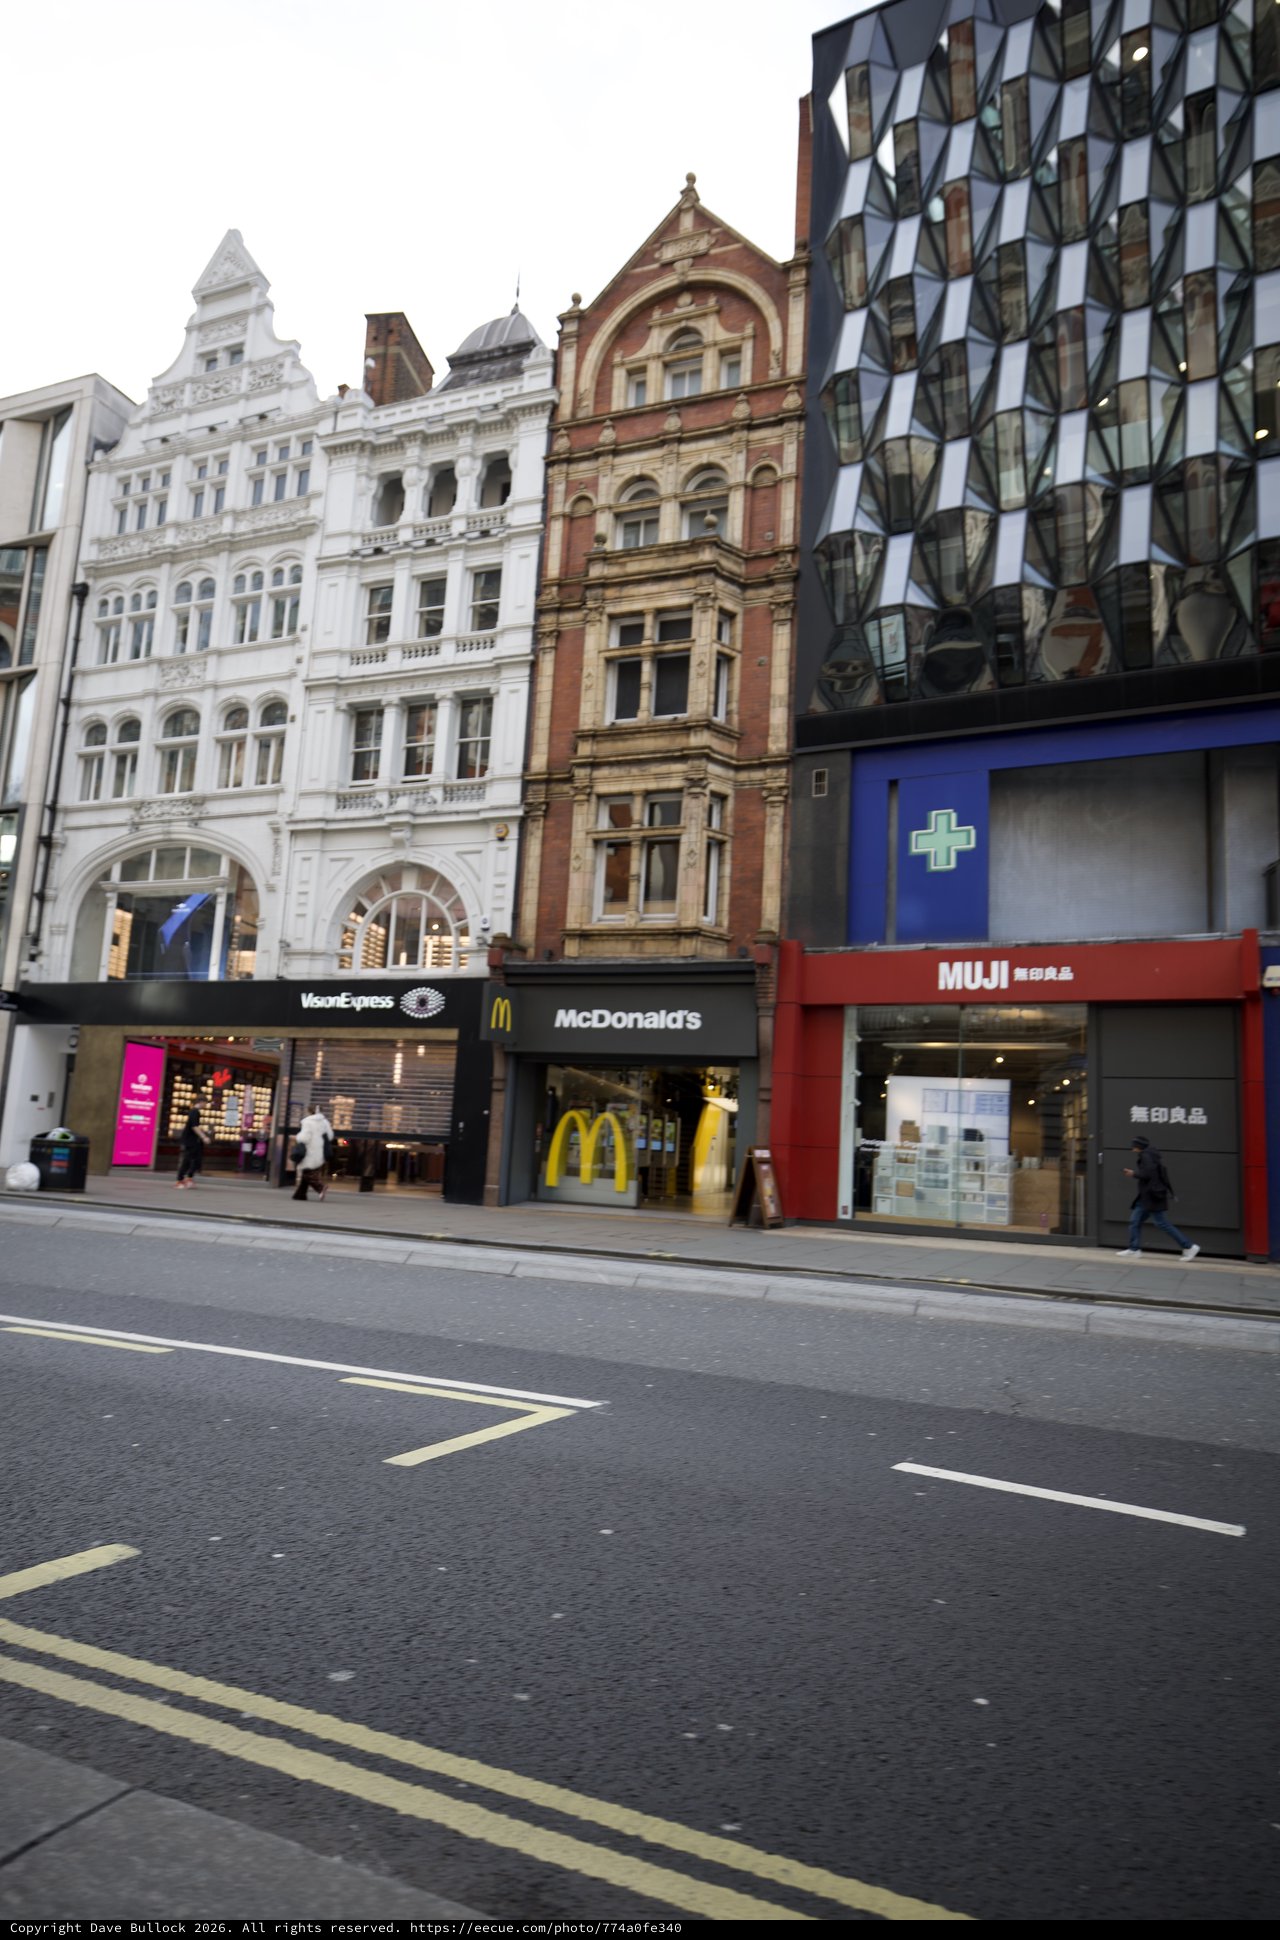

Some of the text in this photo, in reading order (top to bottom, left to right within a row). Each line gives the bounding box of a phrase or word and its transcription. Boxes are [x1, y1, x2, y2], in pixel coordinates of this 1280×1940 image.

[938, 960, 1074, 990] MUJI 無印良品
[554, 1009, 702, 1030] McDonald's
[1130, 1105, 1207, 1125] 無印良品
